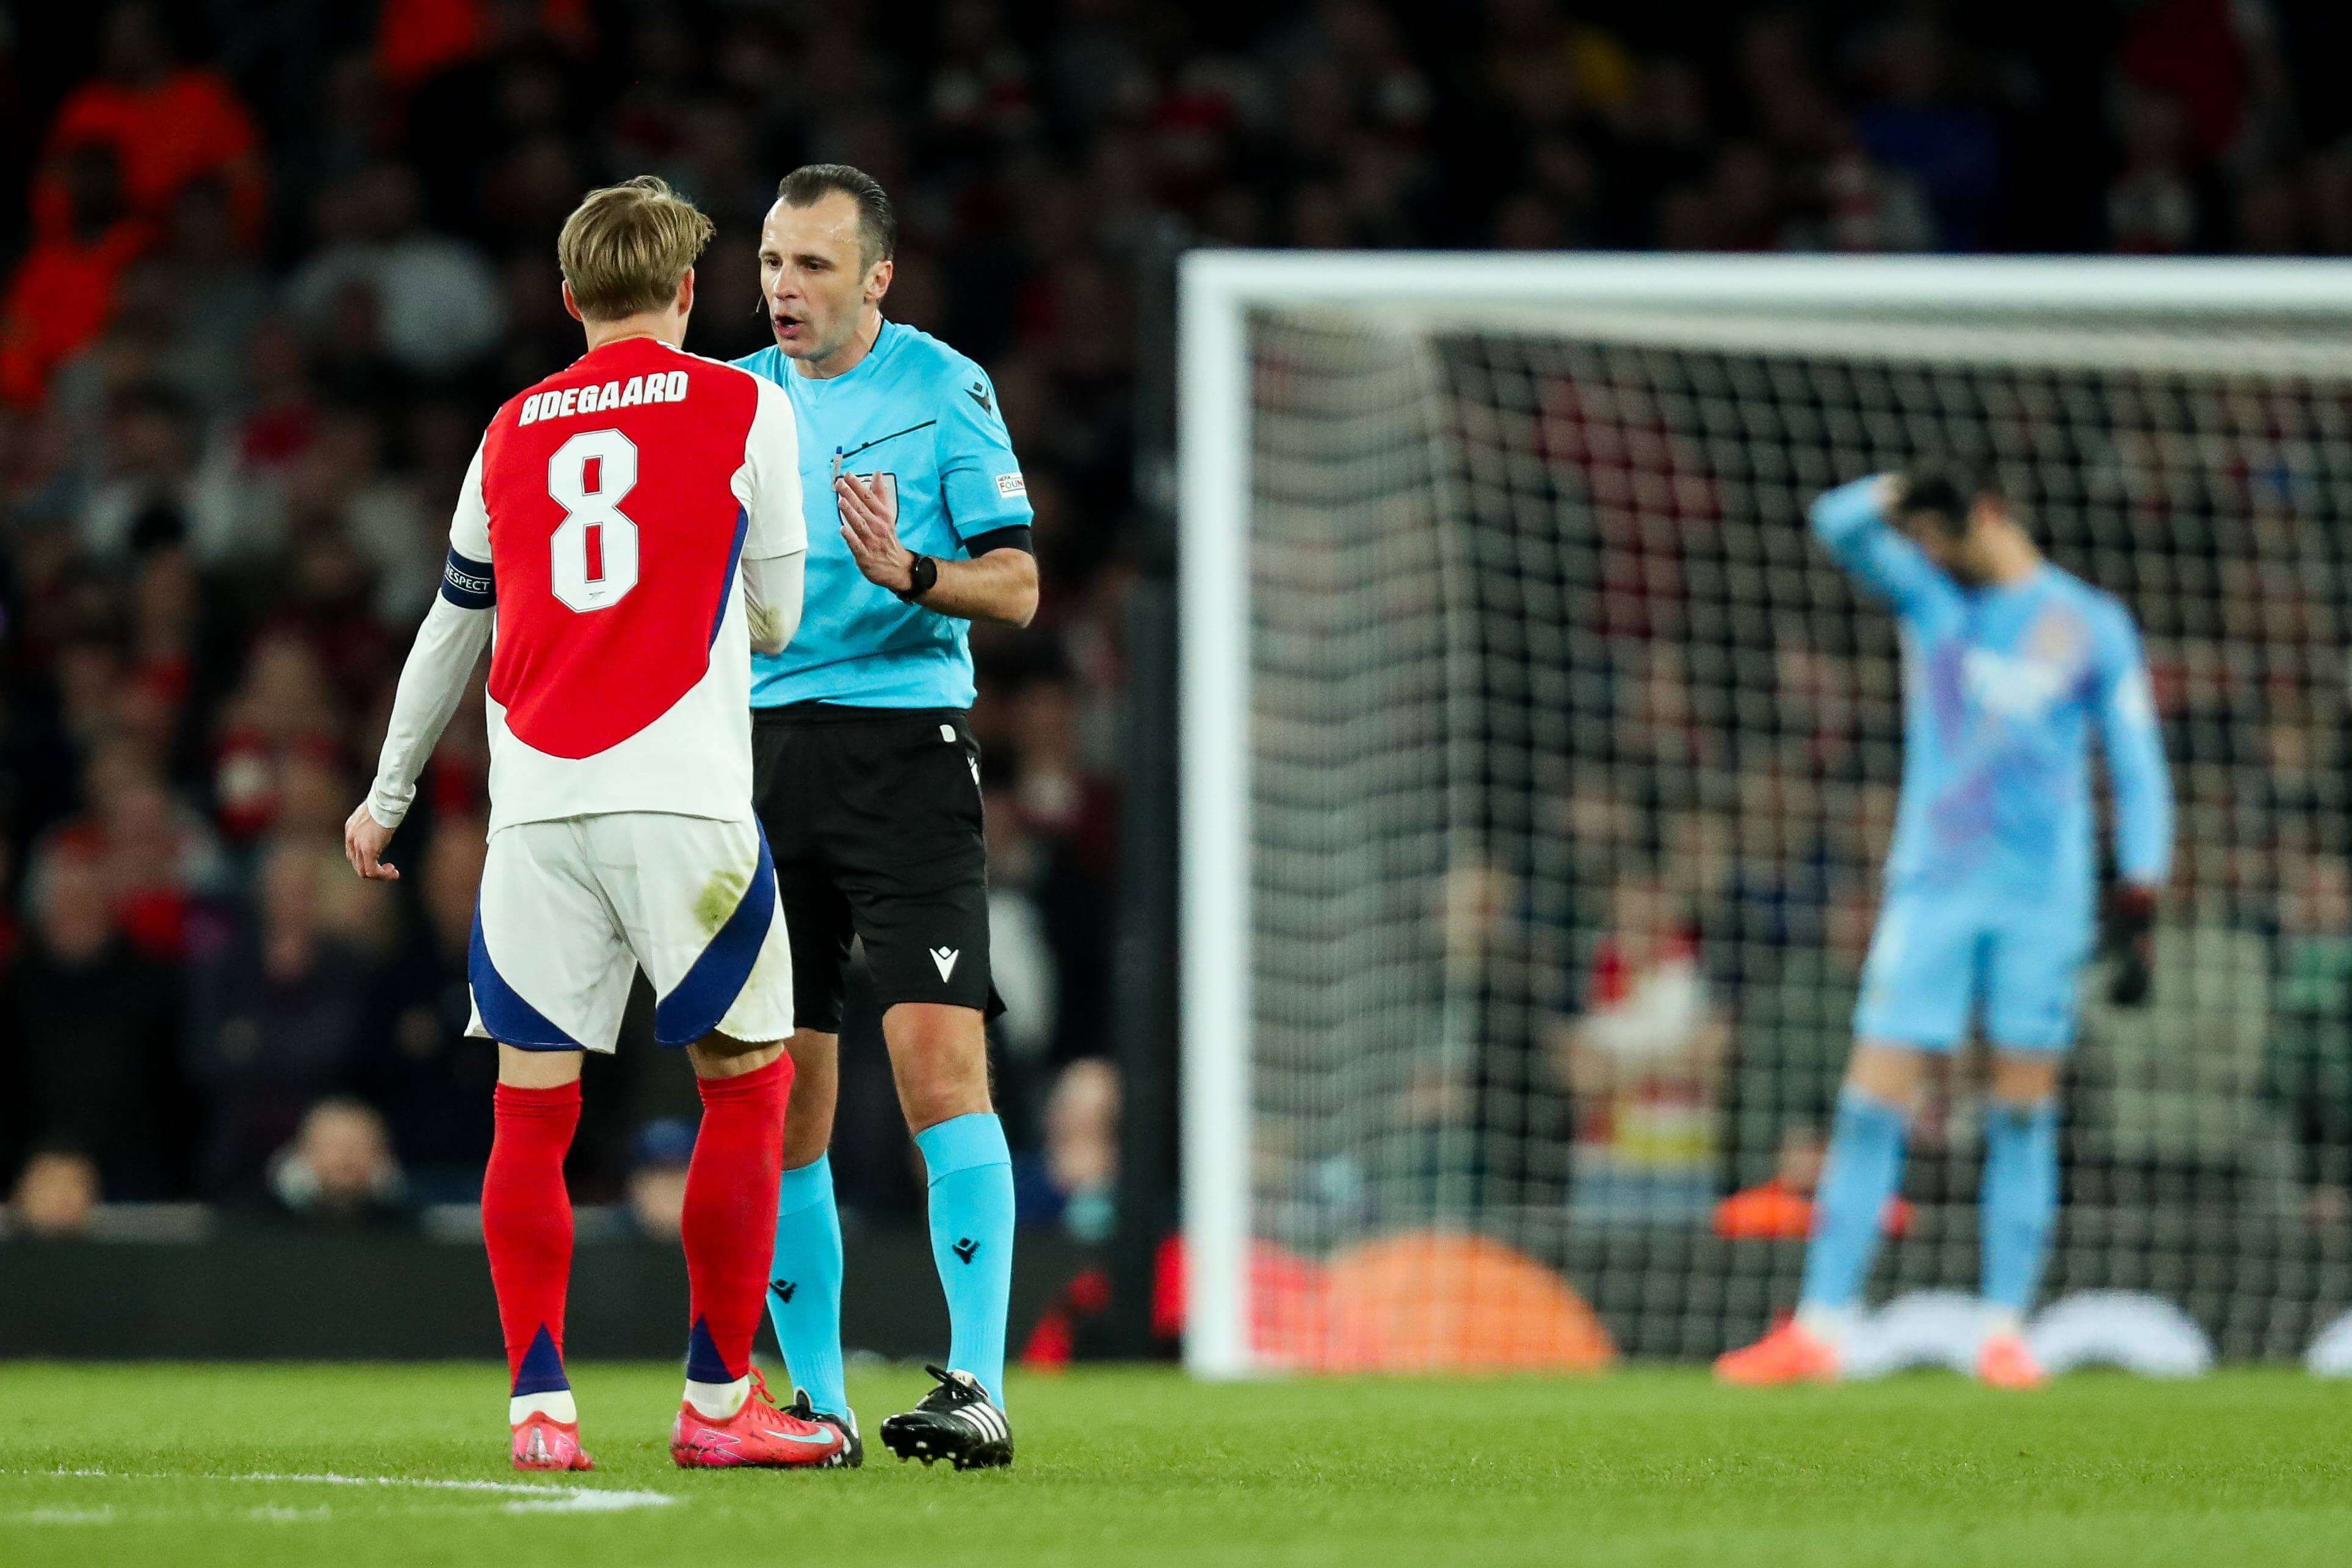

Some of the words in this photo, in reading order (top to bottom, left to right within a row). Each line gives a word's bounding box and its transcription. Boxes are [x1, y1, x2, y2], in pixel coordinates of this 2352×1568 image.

[518, 370, 689, 427] ØDEGAARD
[548, 428, 638, 613] 8
[446, 563, 490, 591] RESPECT
